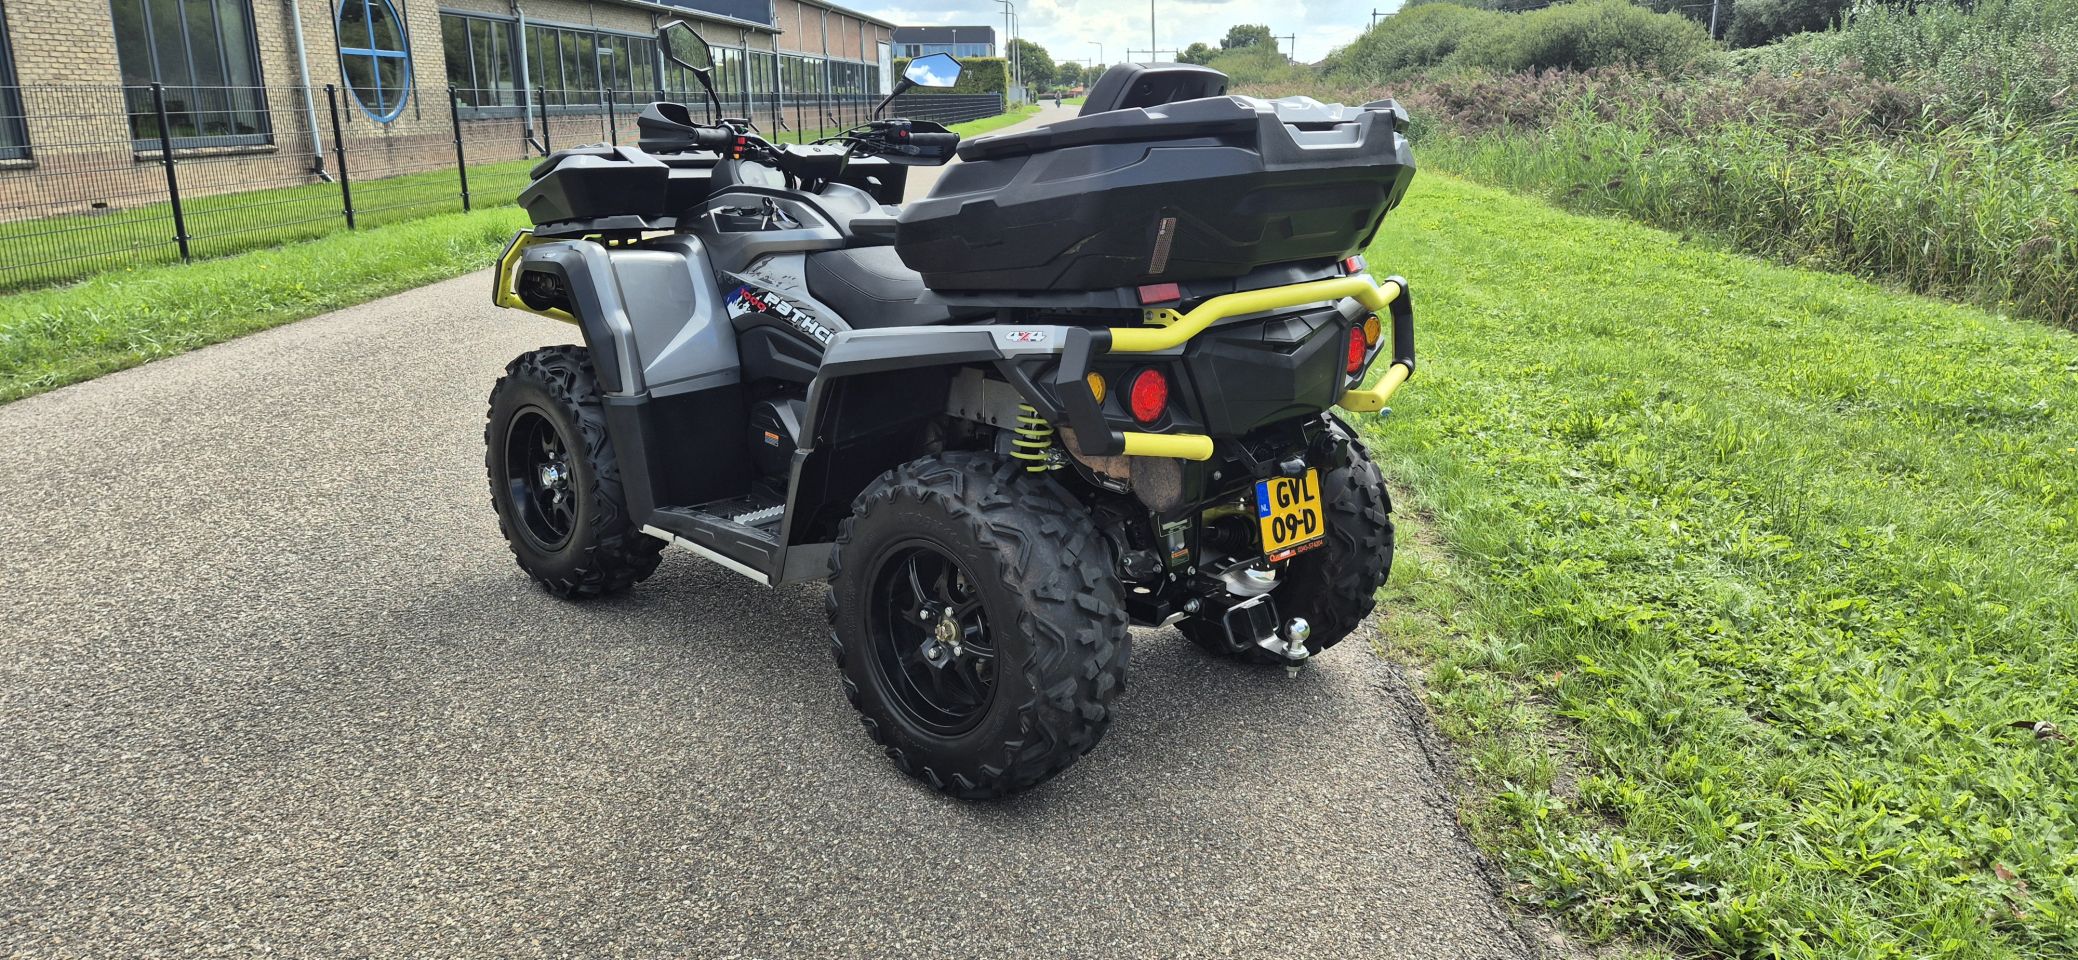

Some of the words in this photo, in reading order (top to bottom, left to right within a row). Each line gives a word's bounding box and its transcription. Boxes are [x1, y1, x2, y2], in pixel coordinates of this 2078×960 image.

[1260, 504, 1268, 512] NL
[1276, 477, 1314, 509] GVL
[1272, 508, 1316, 544] 09-D
